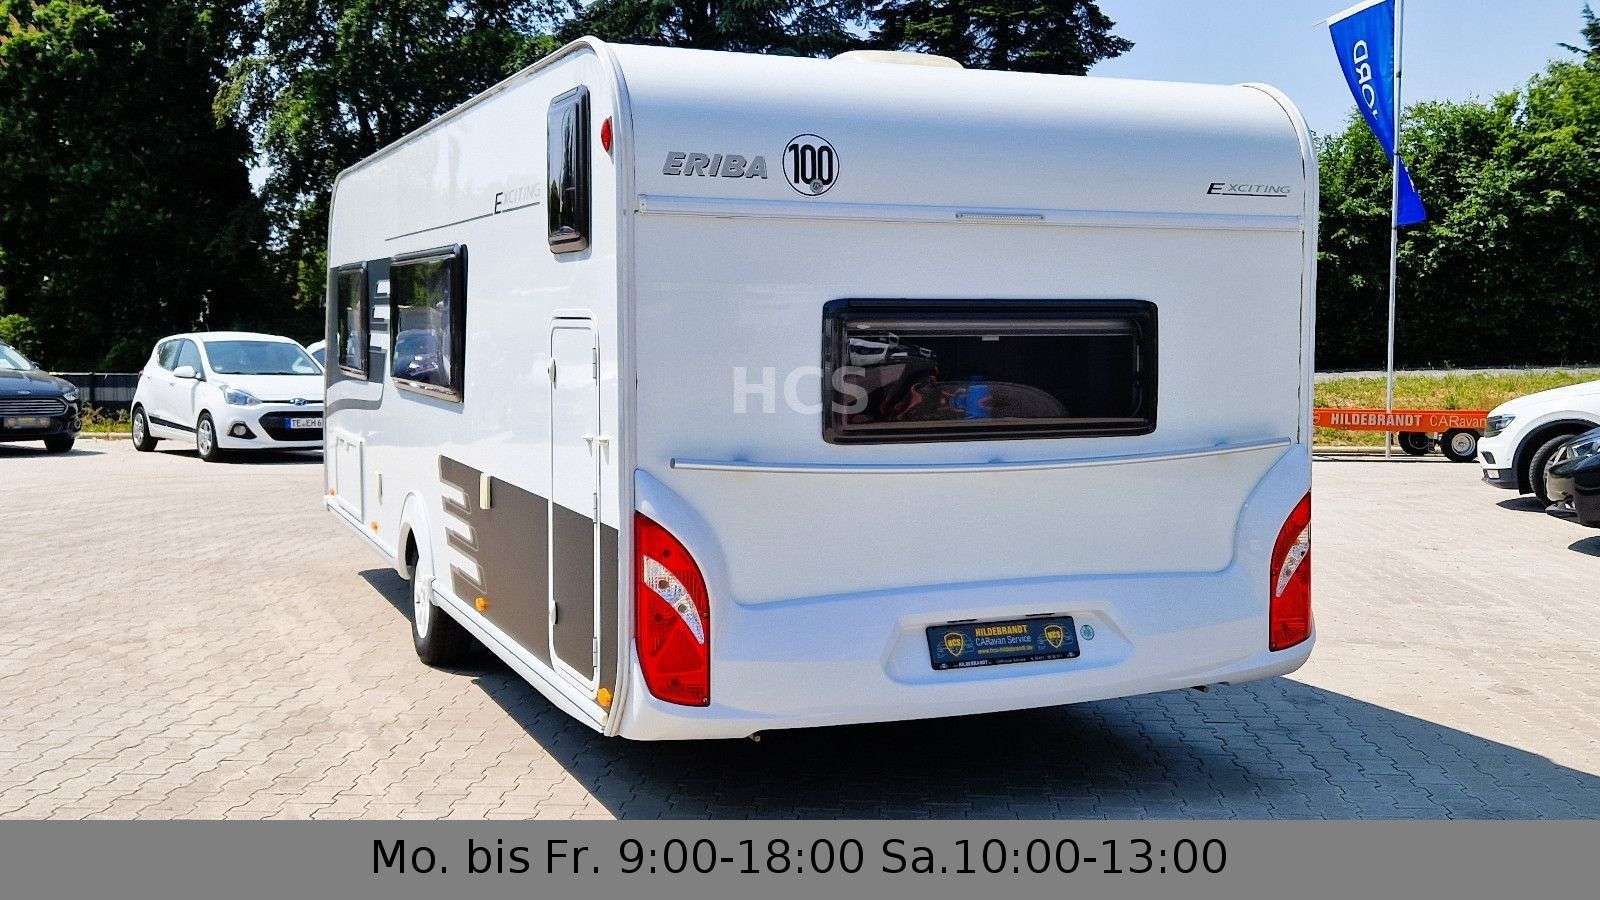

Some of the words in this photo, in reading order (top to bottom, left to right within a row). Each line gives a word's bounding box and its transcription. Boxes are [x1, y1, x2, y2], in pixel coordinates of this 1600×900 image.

[662, 151, 768, 180] ERIBA
[788, 143, 834, 186] 100
[1330, 413, 1423, 427] HILDEBRANDT
[975, 624, 1028, 637] HILDEBRANDT
